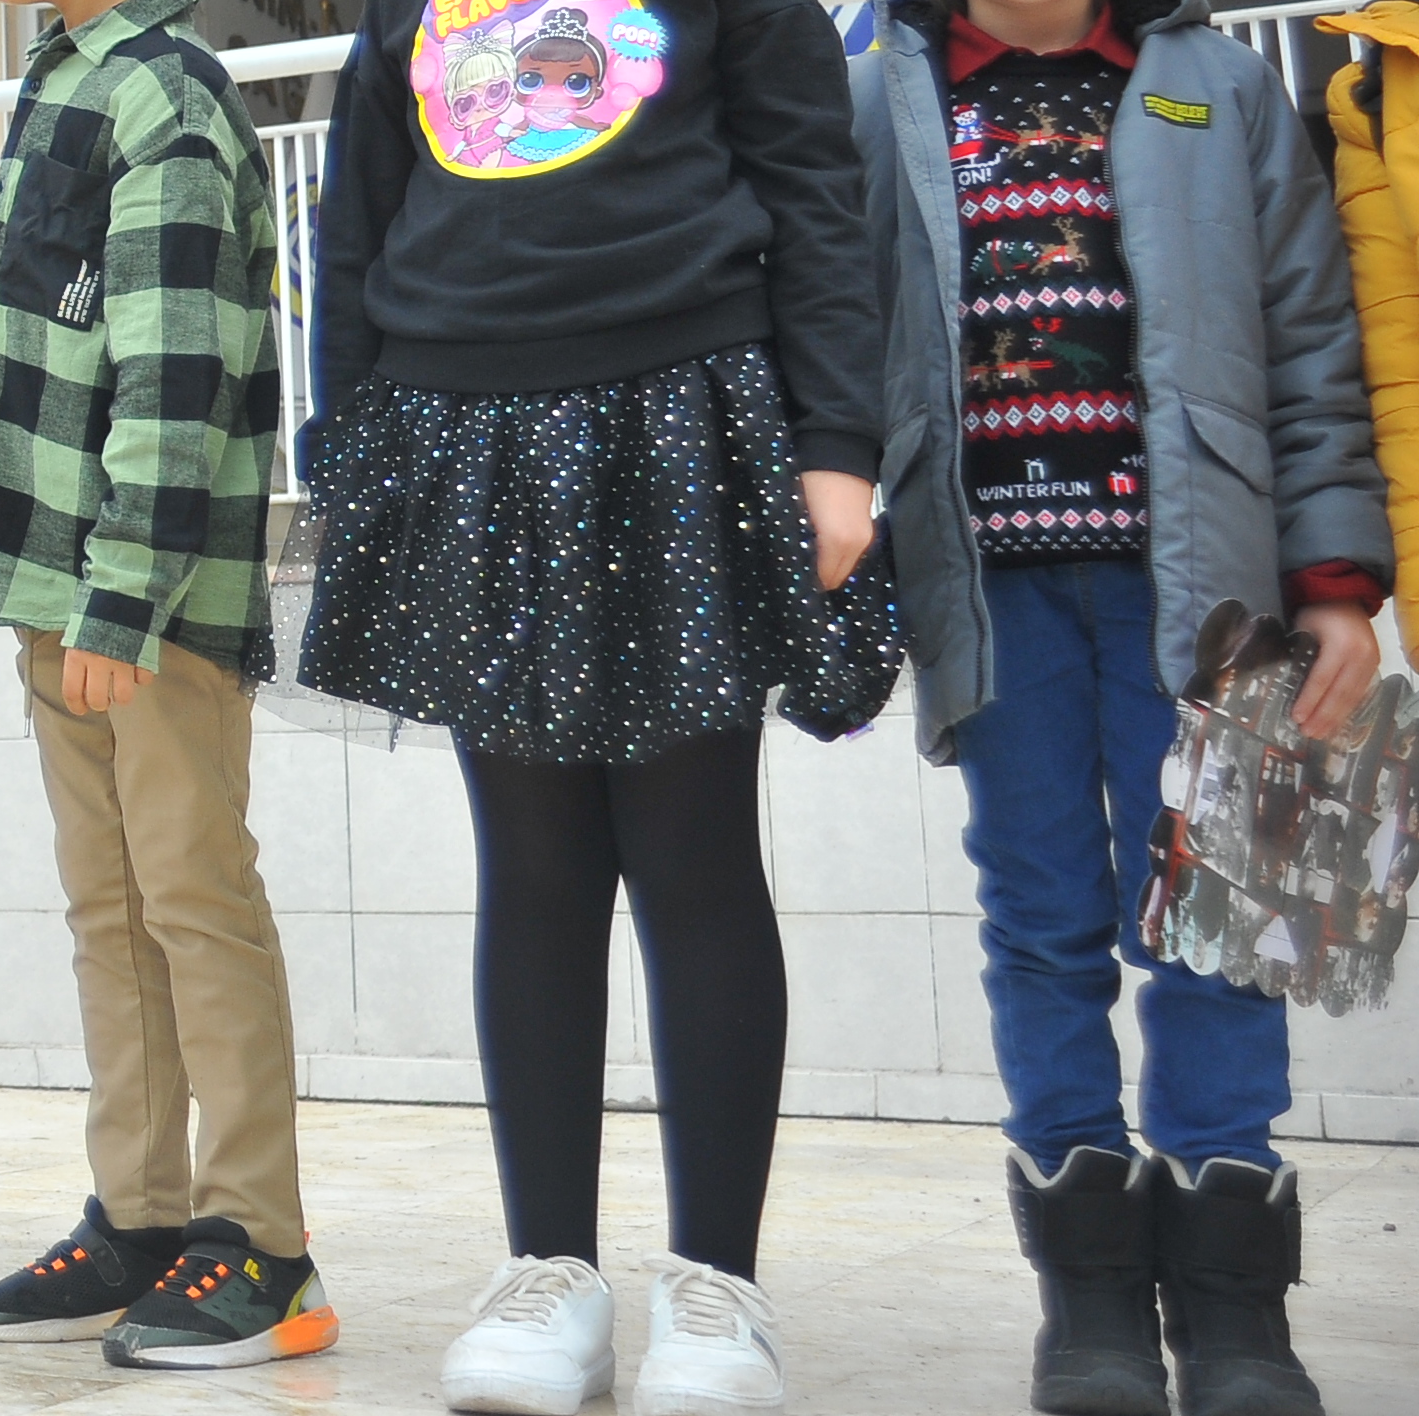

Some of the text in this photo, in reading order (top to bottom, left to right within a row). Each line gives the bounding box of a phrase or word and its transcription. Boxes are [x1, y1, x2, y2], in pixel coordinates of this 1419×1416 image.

[612, 23, 658, 50] POP!
[957, 168, 992, 186] ON!
[976, 481, 1091, 502] WINTER FUN
